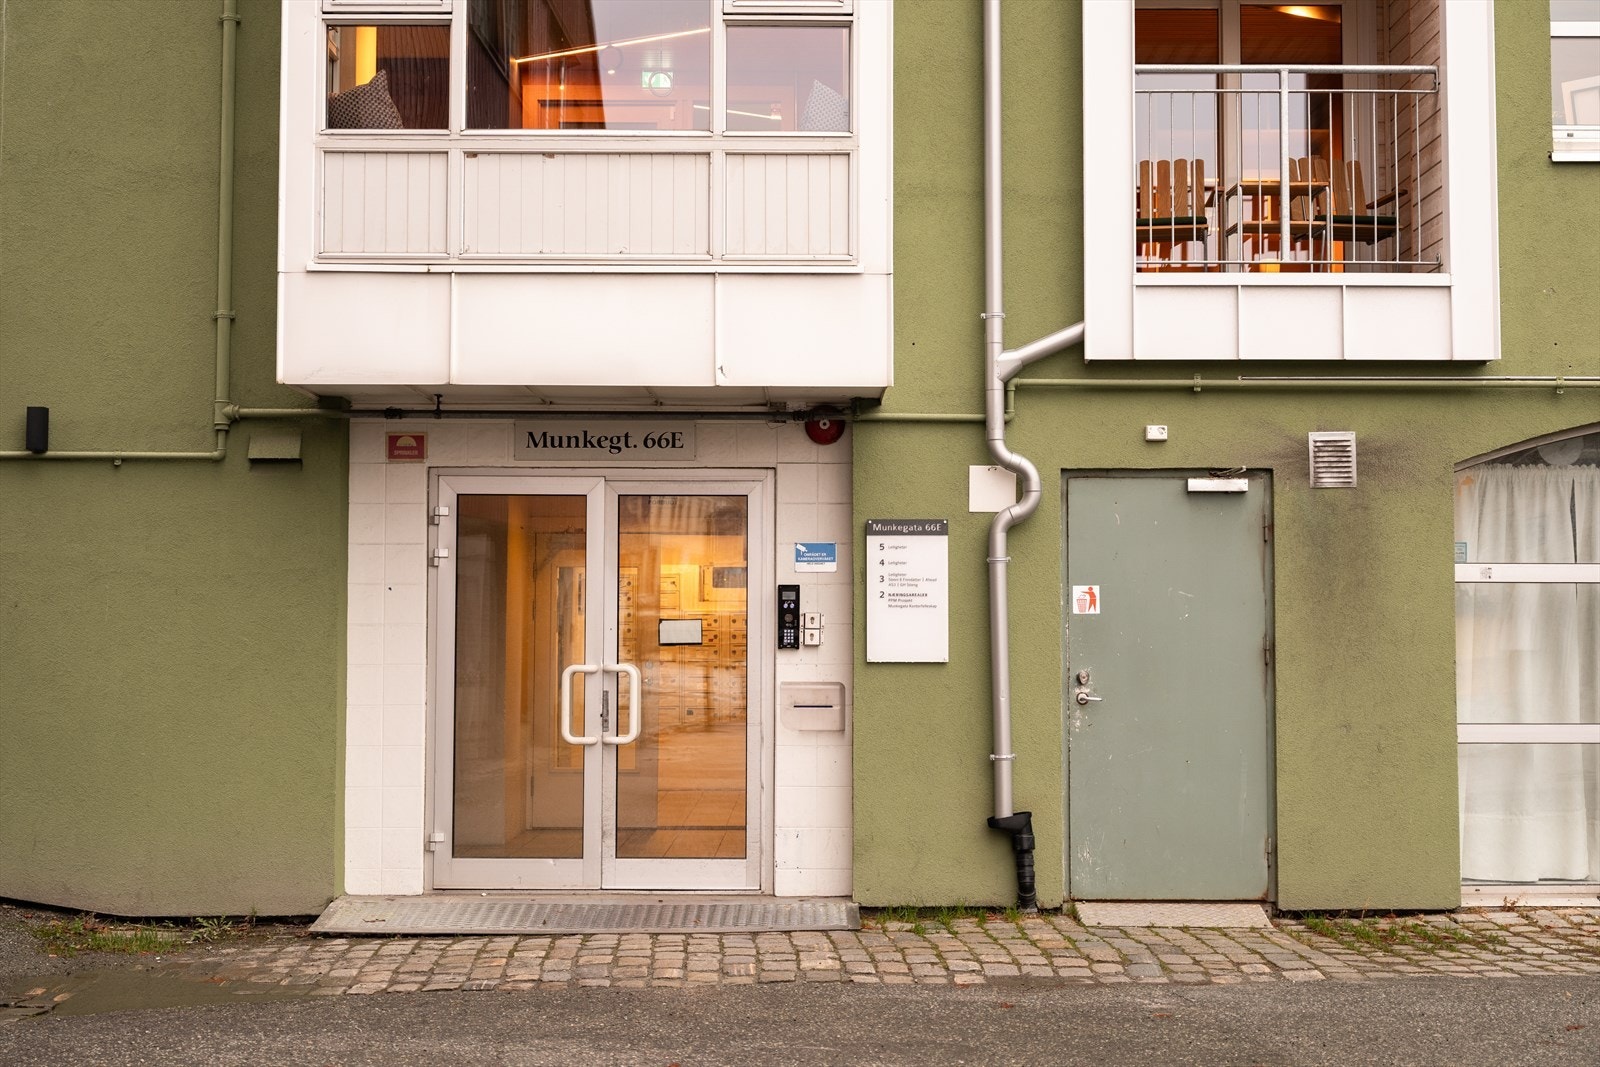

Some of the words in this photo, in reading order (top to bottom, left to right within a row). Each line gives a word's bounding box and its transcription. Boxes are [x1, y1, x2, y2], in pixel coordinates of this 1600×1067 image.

[525, 430, 637, 455] Munkegt.
[643, 431, 684, 449] 66E
[872, 523, 923, 533] Munkegata
[925, 523, 942, 531] 66E
[879, 543, 885, 551] 5
[879, 559, 885, 567] 4
[879, 575, 885, 583] 3
